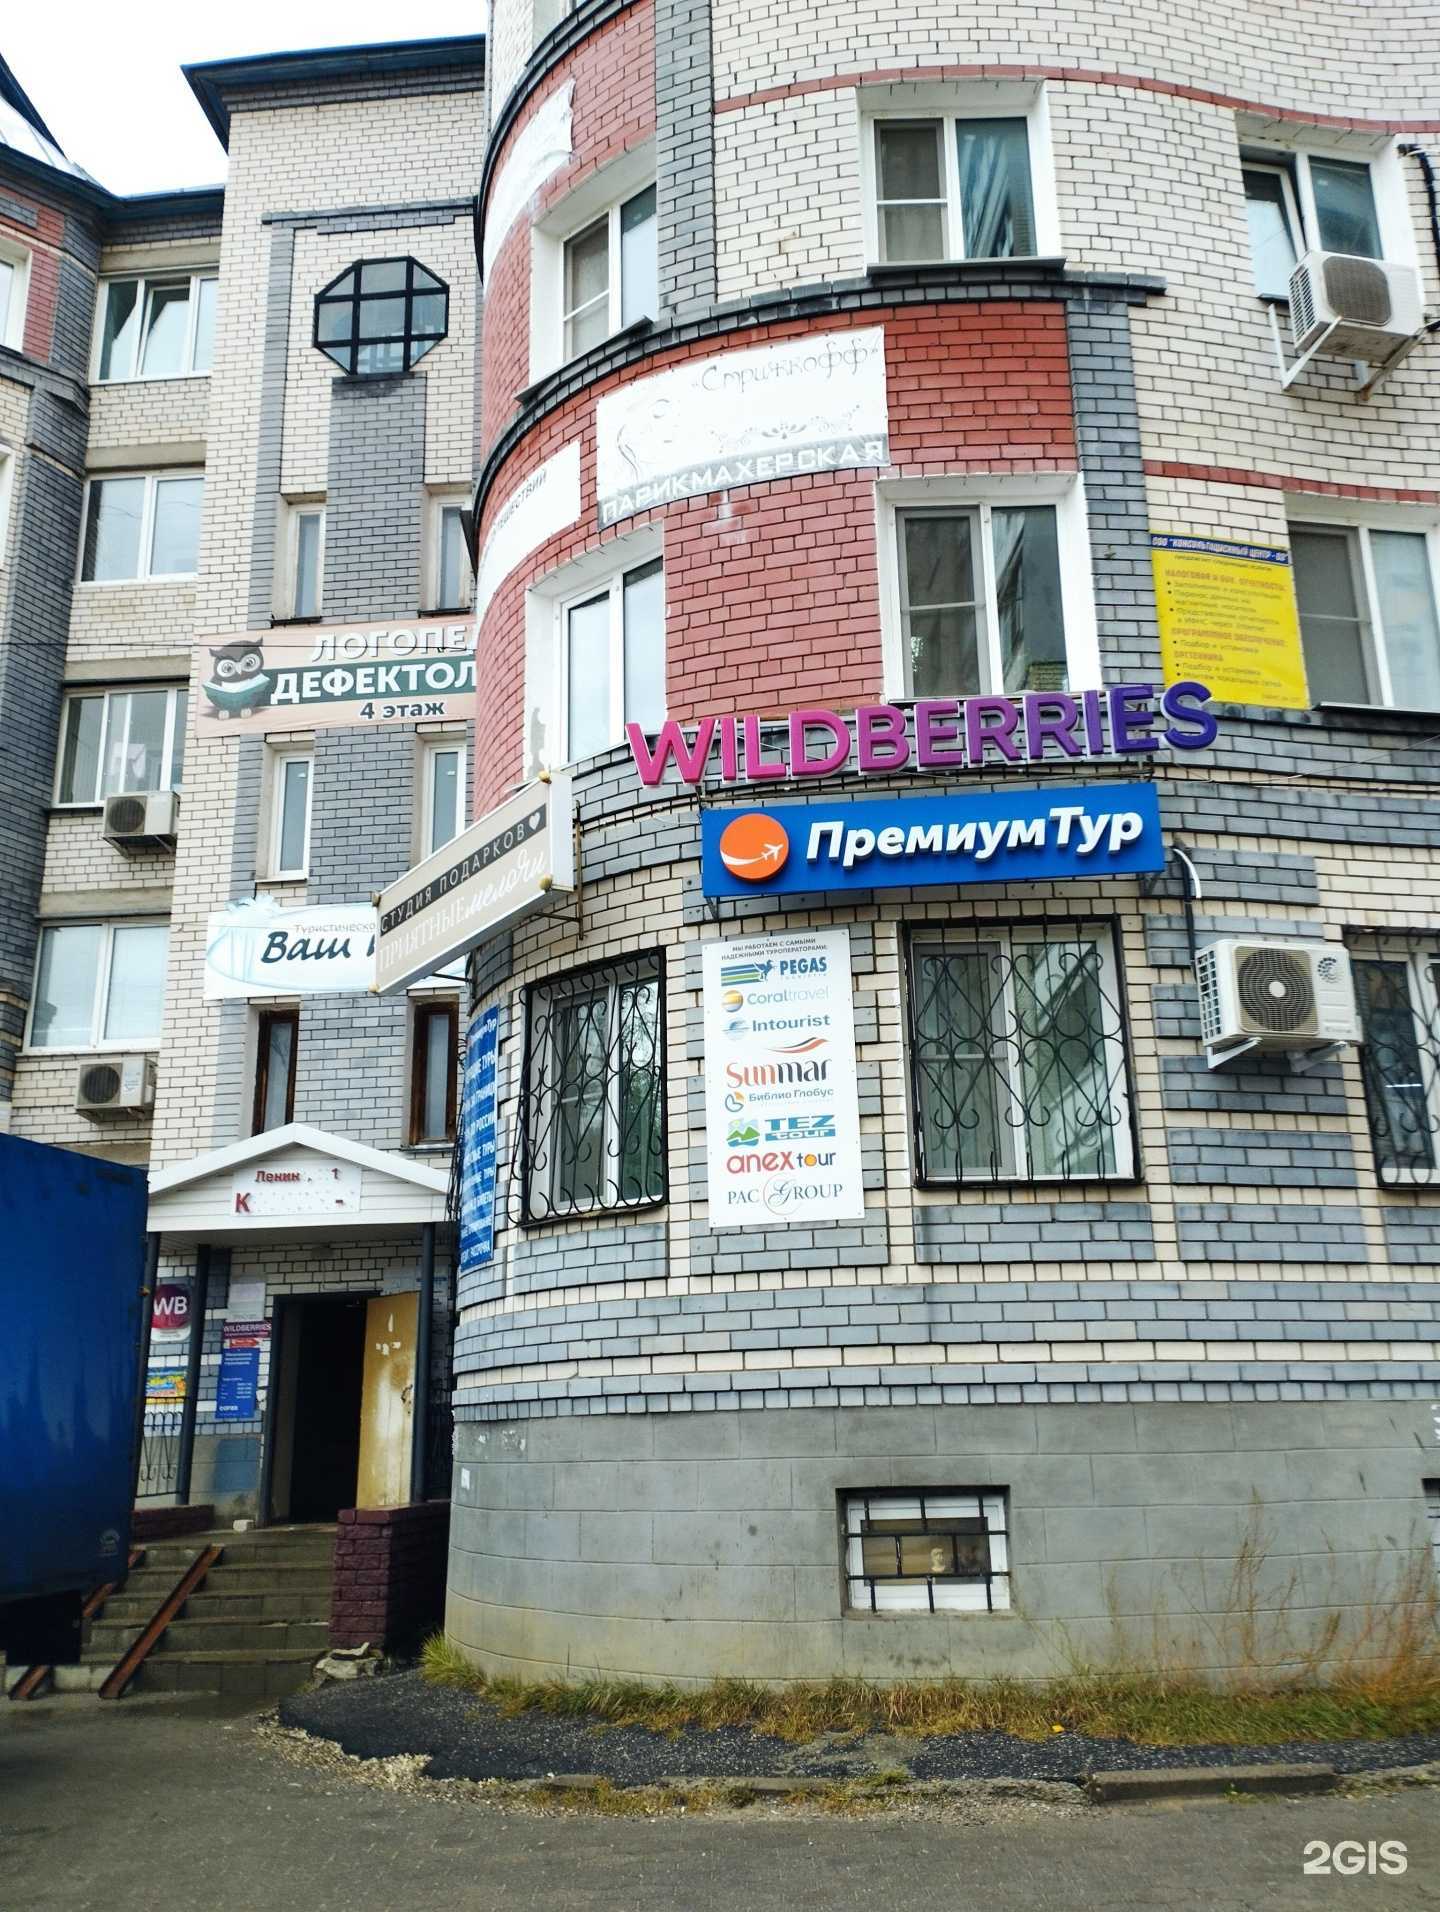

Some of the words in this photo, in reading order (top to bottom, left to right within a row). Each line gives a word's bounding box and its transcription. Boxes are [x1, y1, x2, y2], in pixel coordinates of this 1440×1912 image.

[600, 440, 884, 524] ПАРИКМАХЕРСКАЯ
[270, 661, 477, 705] ДЕФЕКТОЛ
[360, 702, 375, 719] 4
[382, 702, 445, 718] этаж
[625, 681, 1219, 788] WILDBERRIES
[806, 806, 1144, 869] ПремиумТур
[381, 888, 432, 932] СТУДИЯ
[439, 823, 525, 893] ПОДАРКОВ
[261, 931, 351, 964] Ваш
[745, 942, 778, 951] РАБОТАЕМ
[786, 938, 816, 946] САМЫМИ
[780, 956, 827, 975] PEGAS
[752, 1015, 831, 1032] Intourist
[726, 1059, 832, 1088] Sunmar
[749, 1092, 792, 1102] Библио
[793, 1088, 834, 1099] Глобус
[764, 1115, 835, 1131] TEZ
[771, 1129, 830, 1141] tour
[726, 1151, 795, 1174] anex
[796, 1152, 837, 1168] tour
[235, 1192, 251, 1214] К
[728, 1188, 761, 1205] PAC
[767, 1178, 843, 1207] GROUP
[153, 1295, 188, 1316] WB
